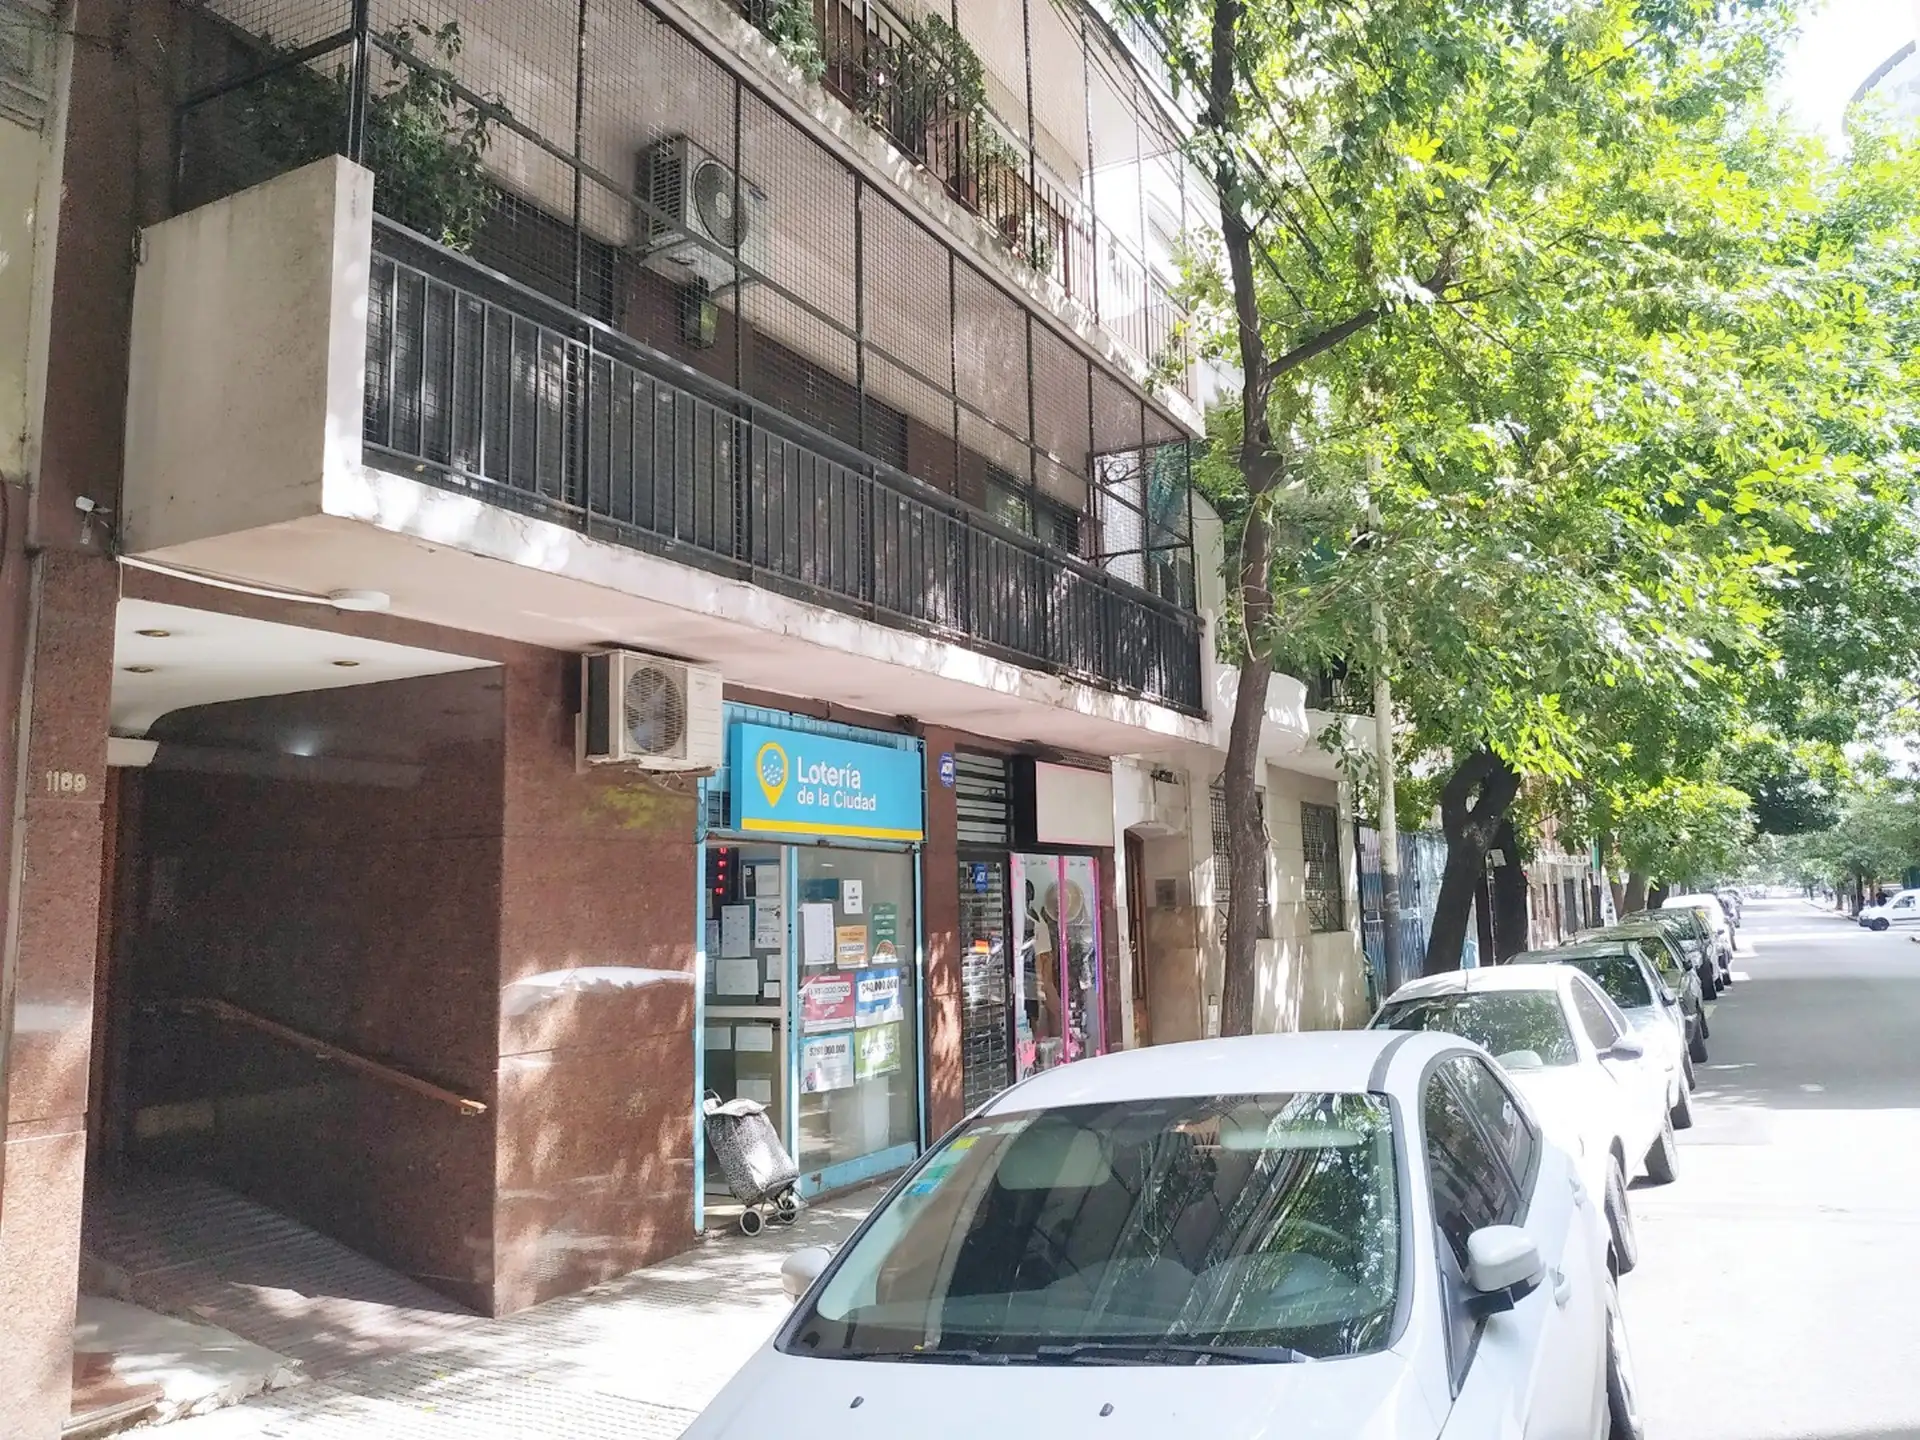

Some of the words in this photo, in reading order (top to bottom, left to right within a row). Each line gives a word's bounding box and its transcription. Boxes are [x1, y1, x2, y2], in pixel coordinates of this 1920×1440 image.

[797, 756, 861, 789] Lotería
[797, 786, 814, 806] de
[818, 788, 829, 806] la
[835, 790, 876, 811] Ciudad
